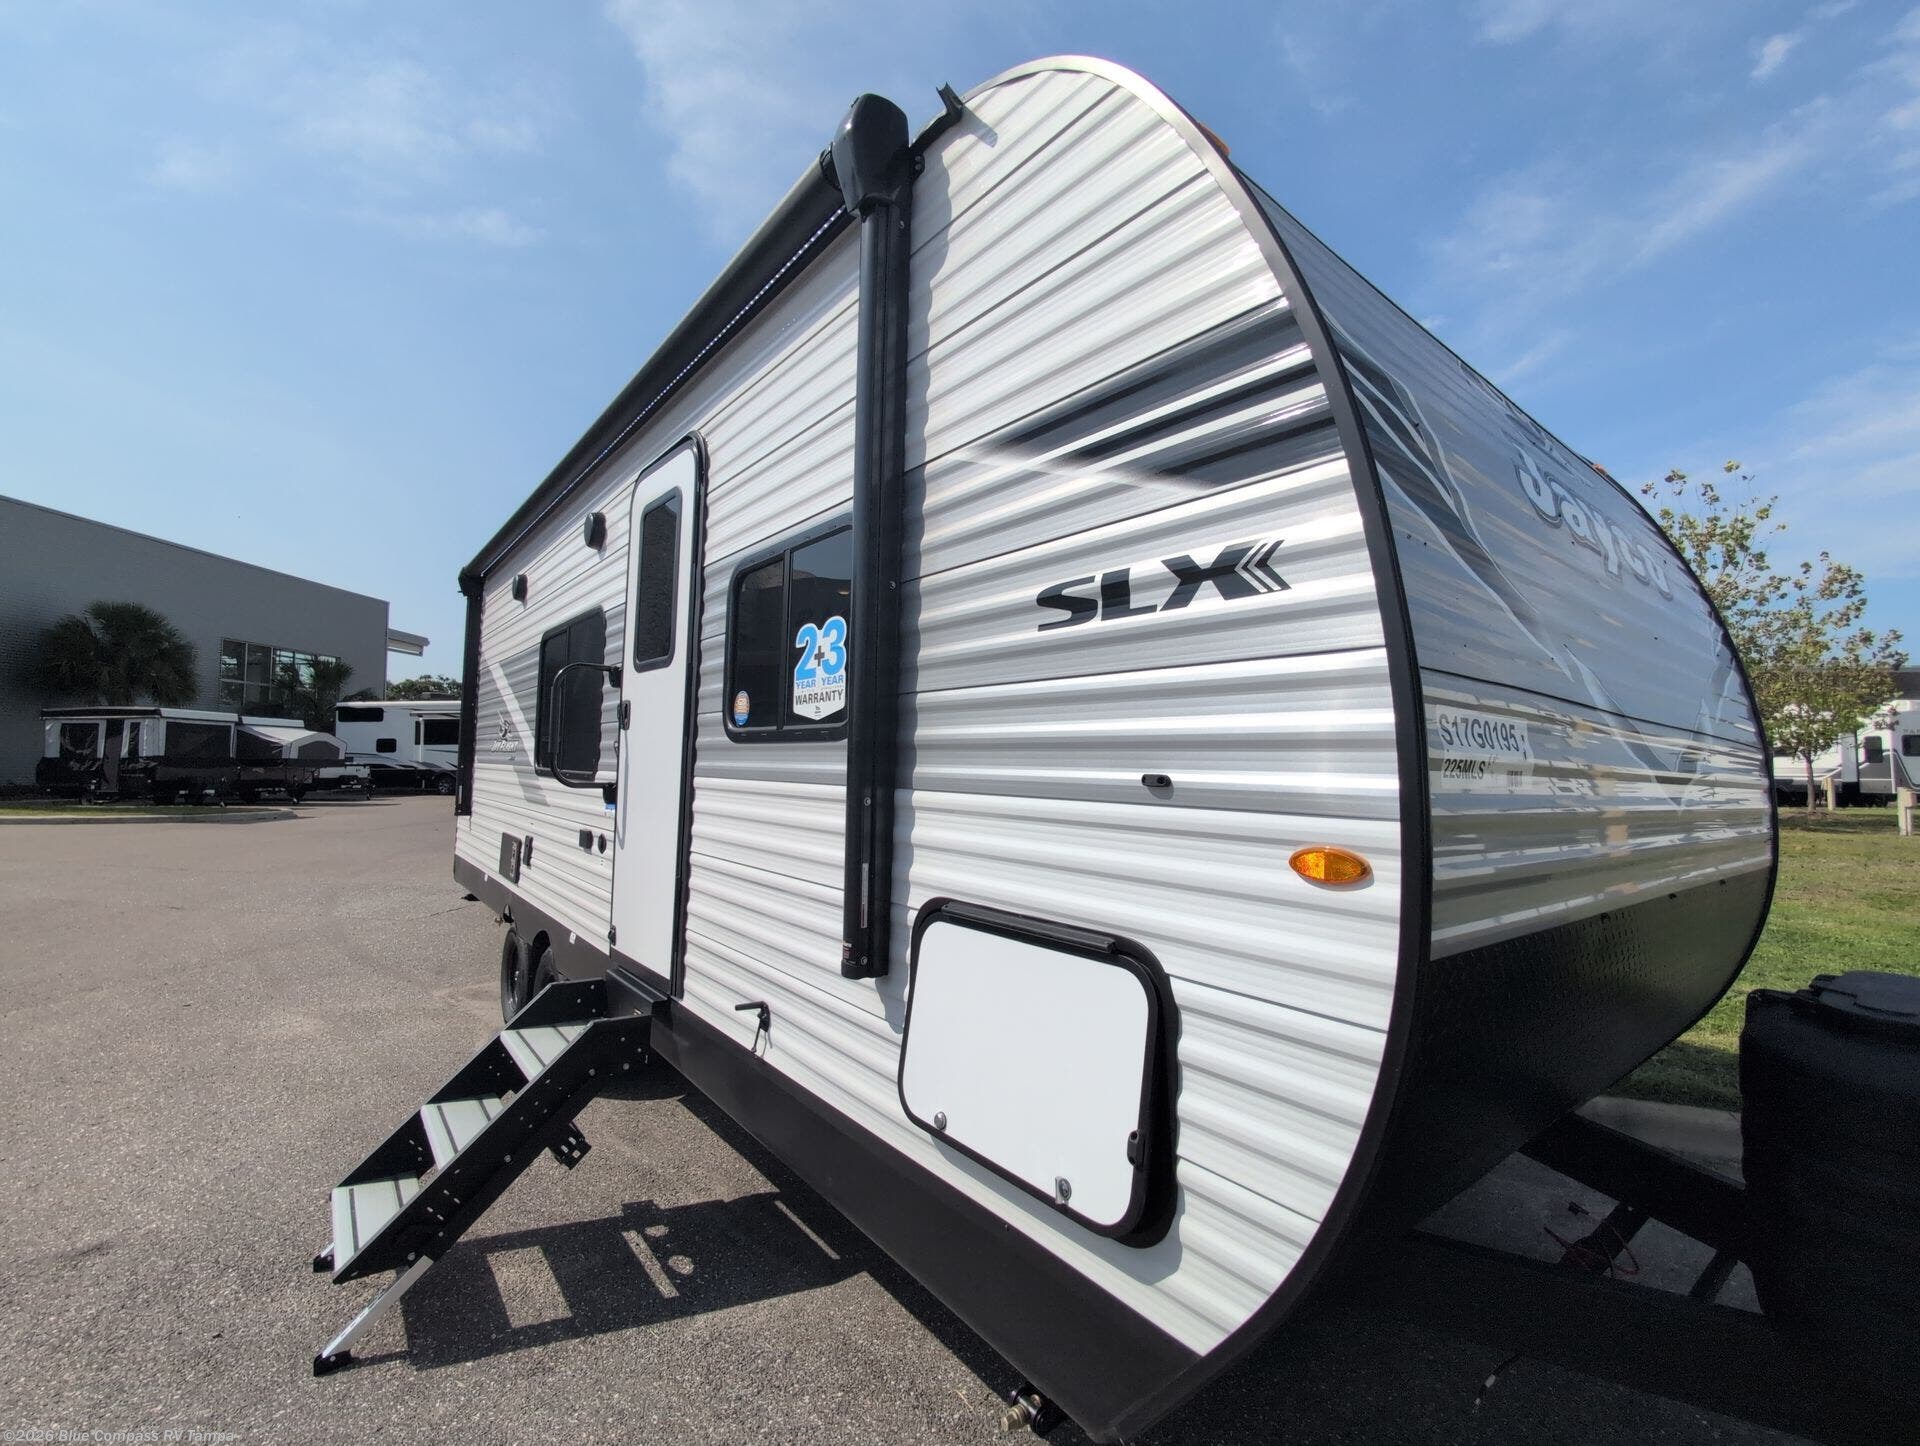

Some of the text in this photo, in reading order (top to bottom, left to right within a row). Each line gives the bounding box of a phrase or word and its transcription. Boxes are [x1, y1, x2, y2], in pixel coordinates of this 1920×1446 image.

[1036, 538, 1292, 632] SLX
[796, 680, 816, 690] YEAR
[821, 675, 844, 686] YEAR
[795, 689, 843, 706] WARRANTY
